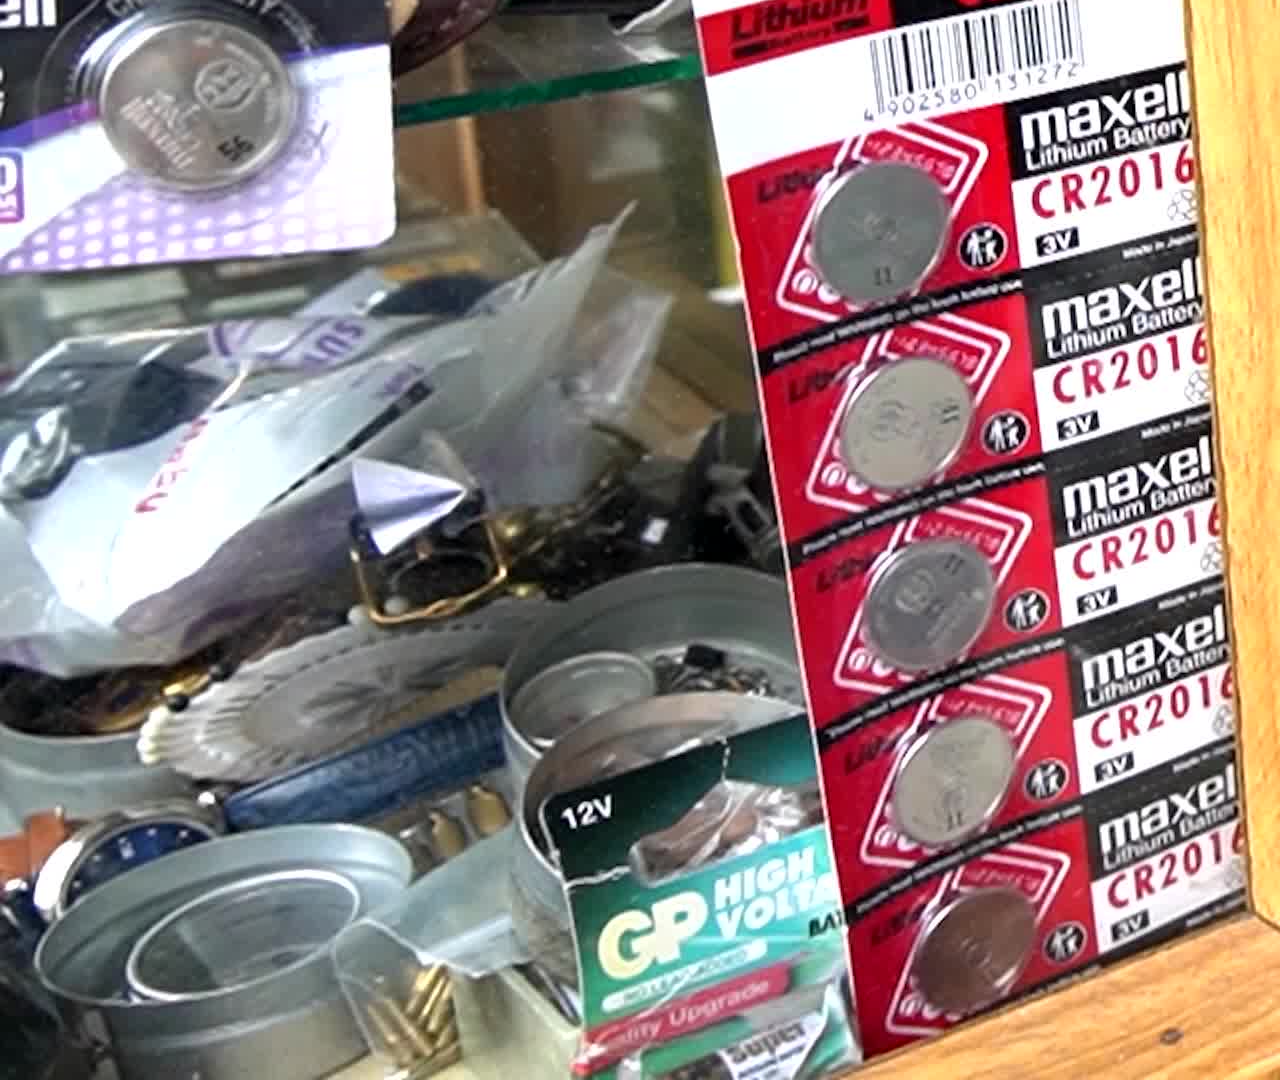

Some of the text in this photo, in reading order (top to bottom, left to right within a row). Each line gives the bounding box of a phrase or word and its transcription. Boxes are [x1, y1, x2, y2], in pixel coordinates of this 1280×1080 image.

[1020, 69, 1190, 151] maxell
[1024, 112, 1192, 172] Lithium Battery
[1030, 148, 1196, 220] CR2016
[1041, 232, 1074, 256] 3V
[1044, 322, 1127, 360] Lithium
[1051, 326, 1209, 403] CR2016
[1063, 413, 1094, 437] 3V
[1067, 503, 1146, 539] Lithium
[1072, 501, 1221, 581] CR2016
[1083, 589, 1112, 612] 3V
[1086, 671, 1161, 708] Lithium
[1090, 665, 1234, 750] CR2016
[561, 794, 613, 830] 12V
[1103, 833, 1176, 871] Lithium
[713, 846, 816, 908] HIGH
[597, 890, 709, 980] GP
[668, 979, 771, 1027] Upgrade
